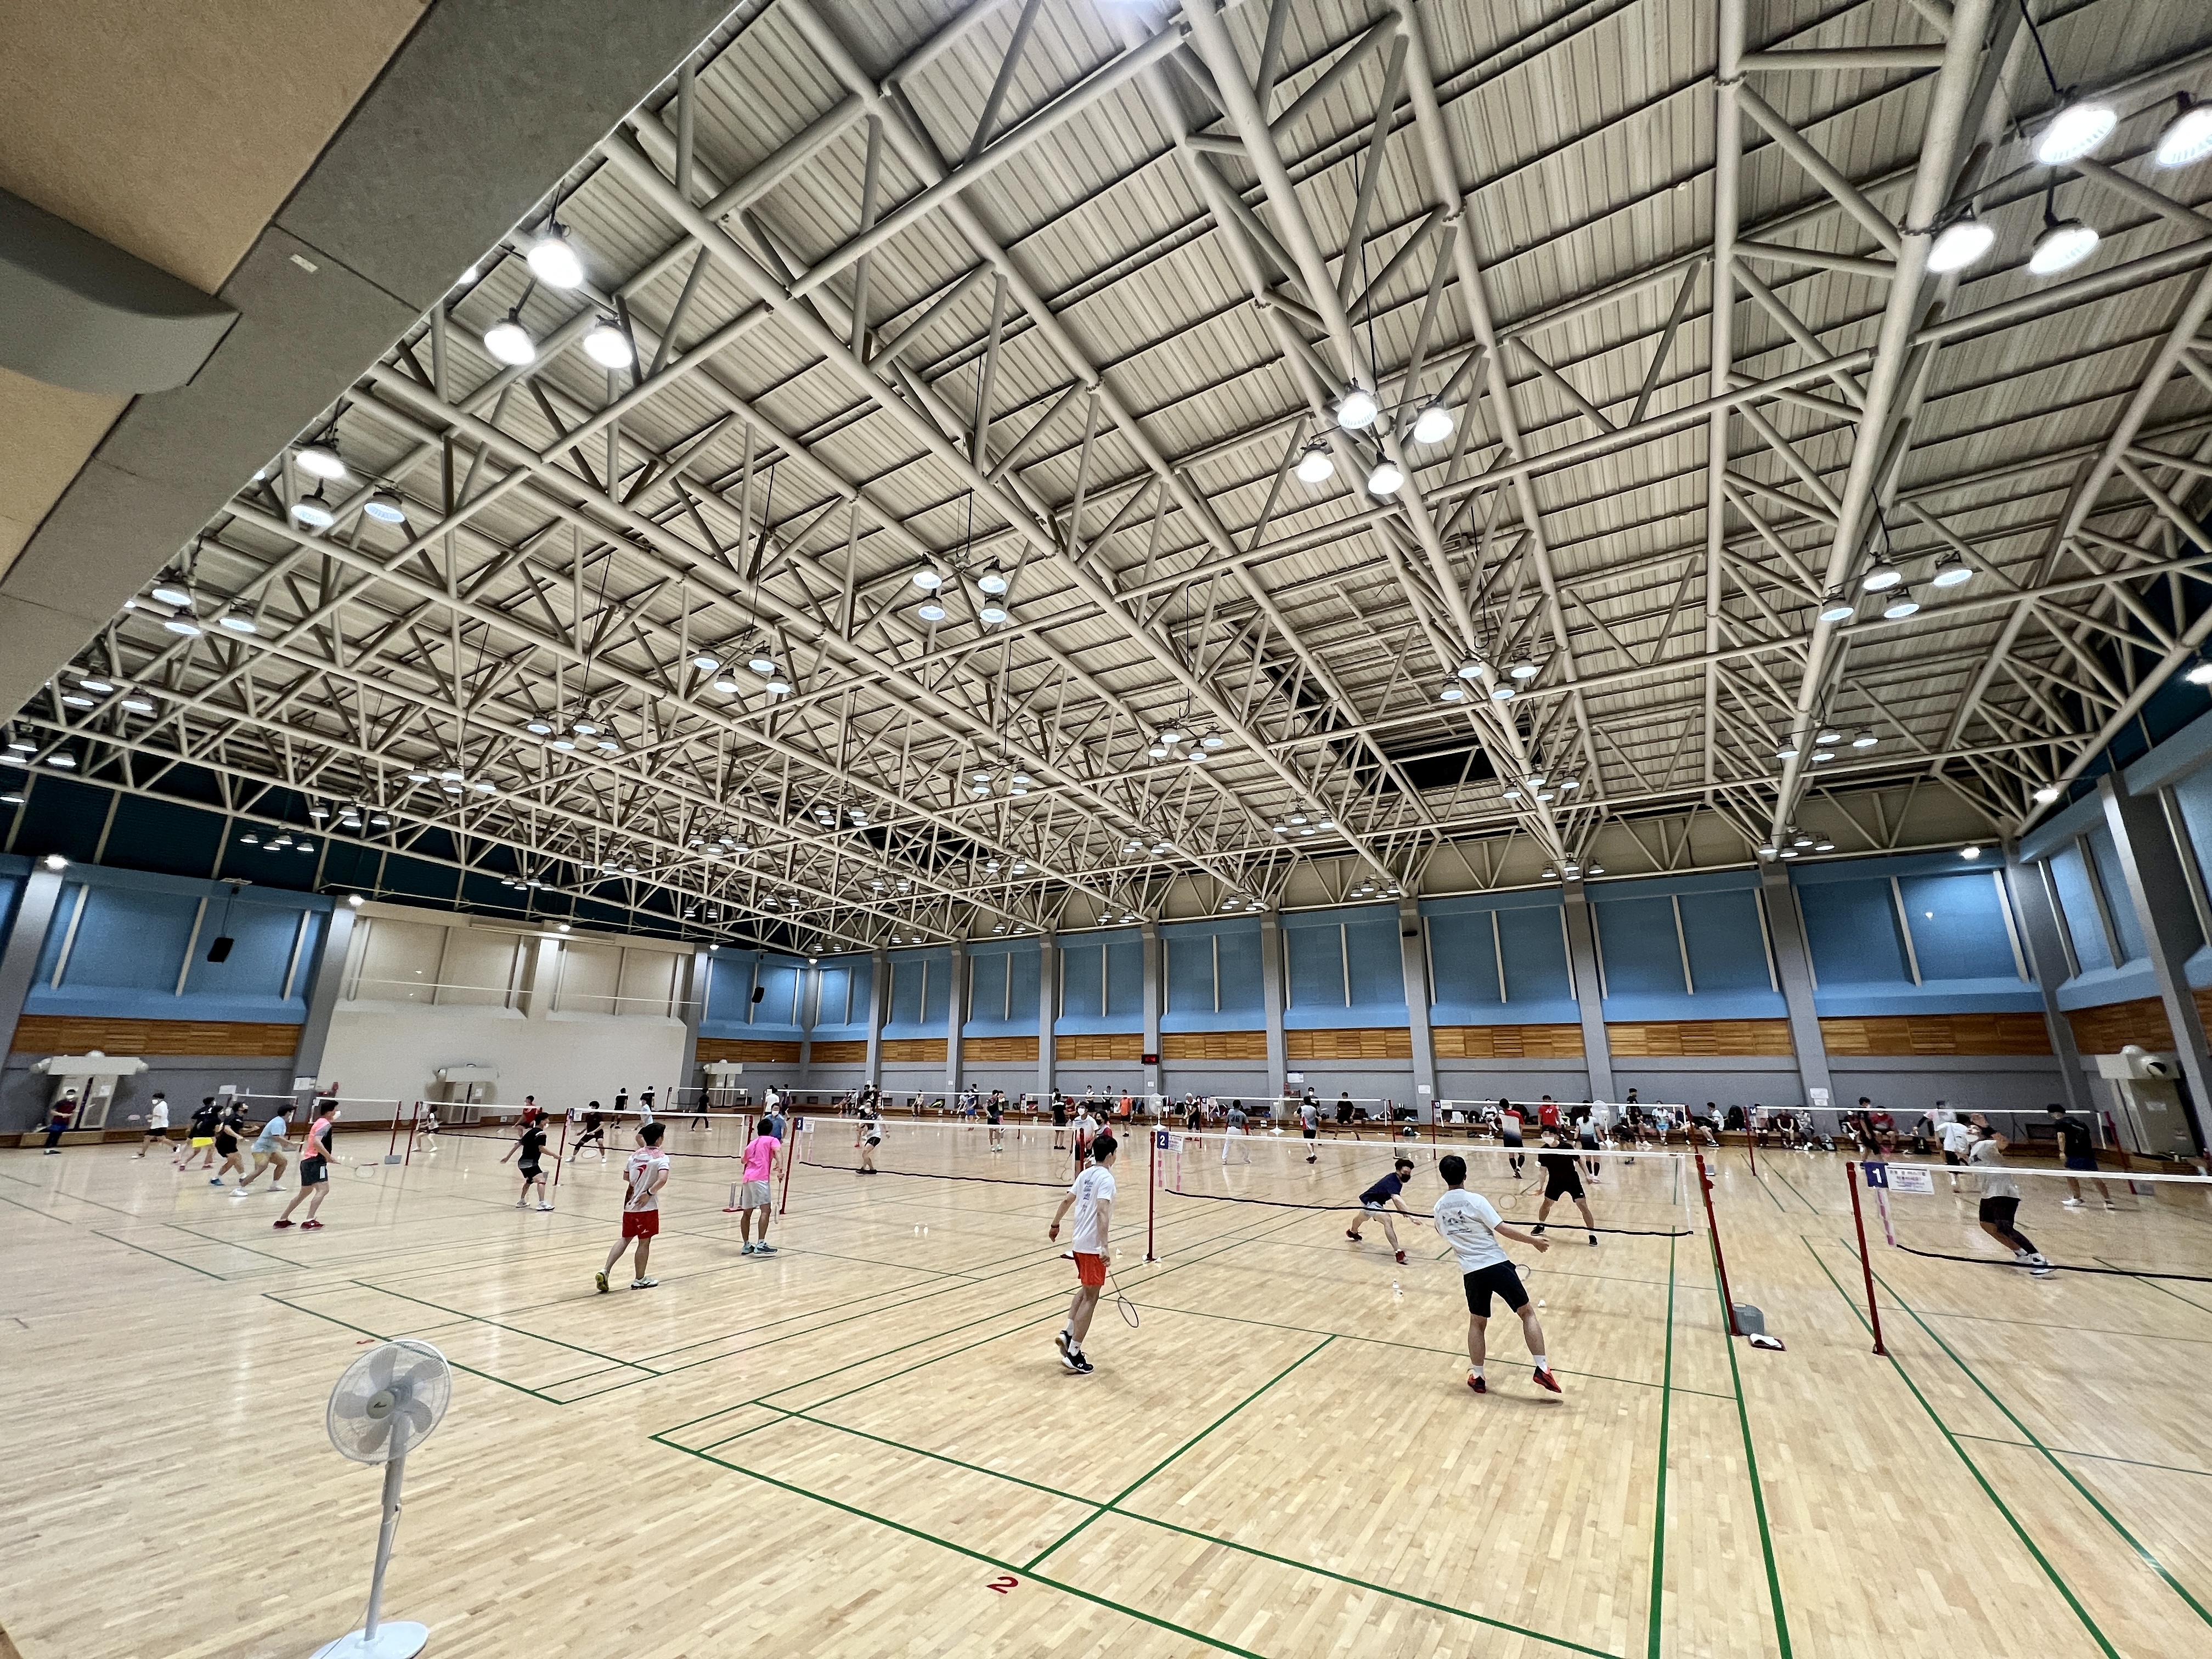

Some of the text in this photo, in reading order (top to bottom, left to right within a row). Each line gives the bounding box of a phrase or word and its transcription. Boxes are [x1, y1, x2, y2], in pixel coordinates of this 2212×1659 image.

[797, 1119, 802, 1128] 3
[1160, 1135, 1165, 1146] 2
[1872, 1168, 1882, 1183] 1
[986, 1576, 1019, 1594] 2
